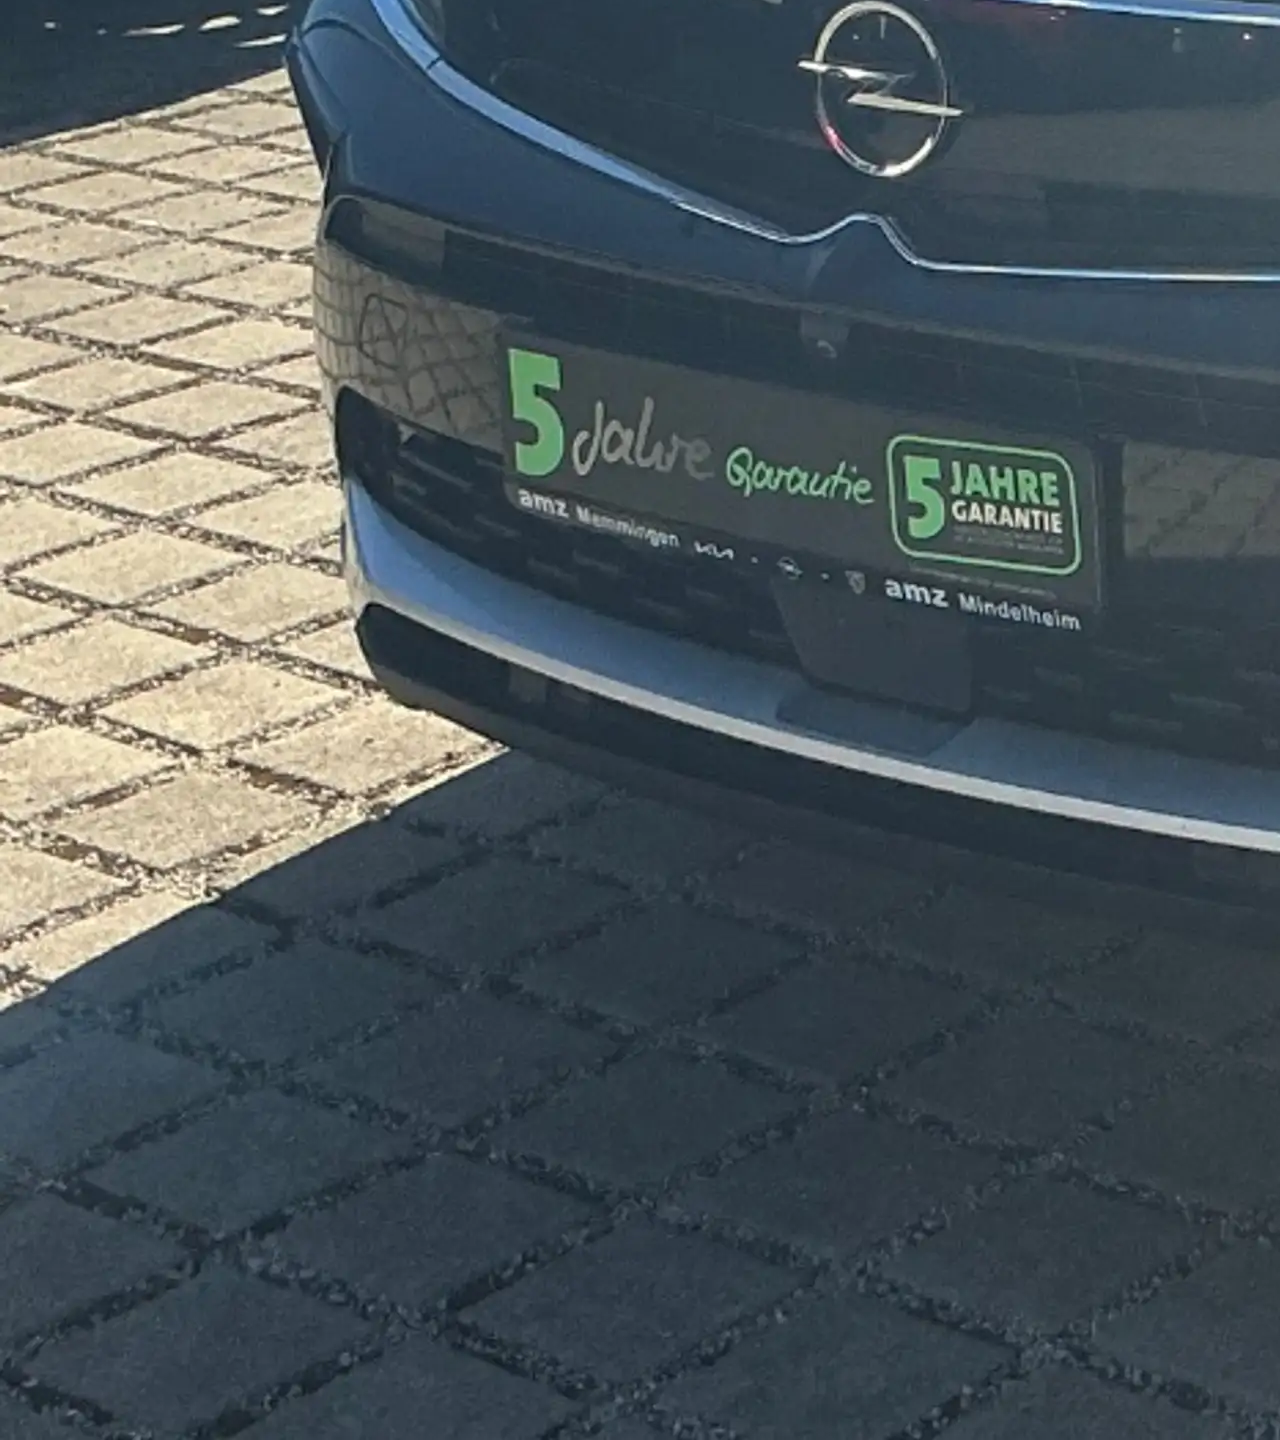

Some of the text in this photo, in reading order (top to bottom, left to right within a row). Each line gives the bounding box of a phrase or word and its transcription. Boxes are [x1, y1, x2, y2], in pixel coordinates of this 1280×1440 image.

[507, 348, 564, 477] 5
[572, 396, 715, 480] Jahre
[517, 488, 570, 519] amz
[575, 504, 681, 548] Memmingen
[903, 454, 1060, 539] 5 JAHRE
[951, 499, 1063, 534] GARANTIE
[884, 578, 949, 608] amz
[957, 592, 1081, 631] Mindelheim
